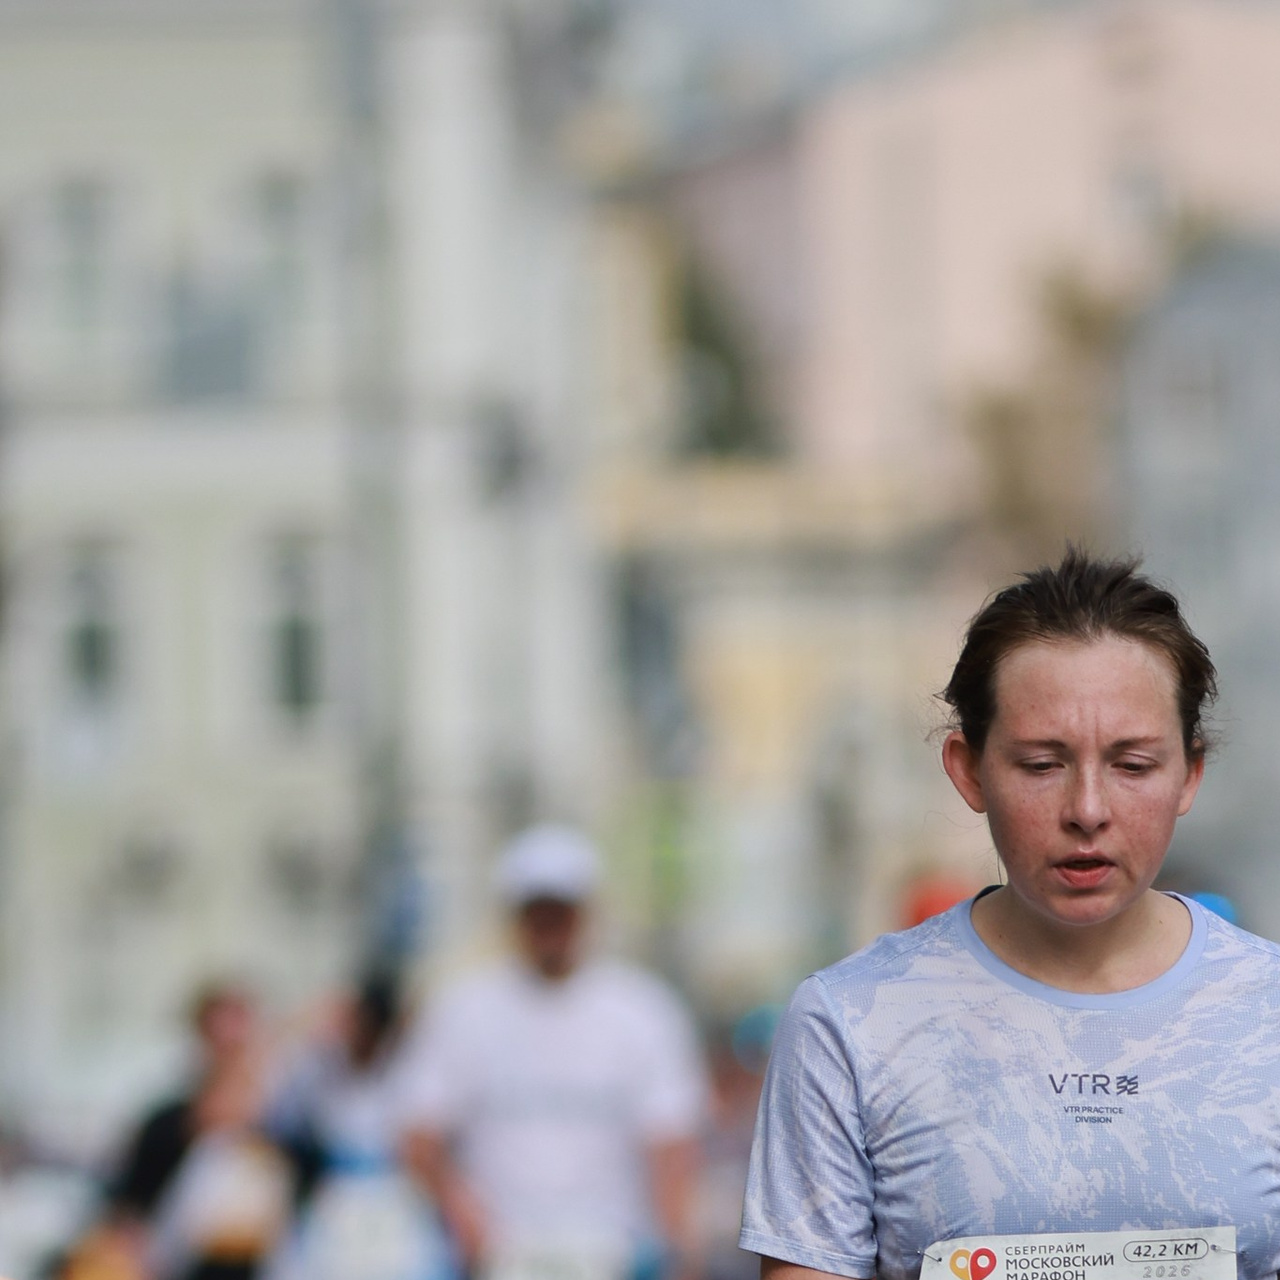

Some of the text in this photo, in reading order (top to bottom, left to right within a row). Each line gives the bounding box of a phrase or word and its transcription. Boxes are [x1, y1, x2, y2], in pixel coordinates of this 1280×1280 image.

[1048, 1074, 1110, 1094] VTR
[1082, 1106, 1124, 1114] PRACTICE
[1075, 1116, 1113, 1124] DIVISION
[1005, 1243, 1086, 1256] СБЕРПРАЙМ
[1132, 1243, 1198, 1258] 42,2 КМ
[1005, 1252, 1114, 1270] МОСКОВСКИЙ
[1142, 1264, 1191, 1279] 2026
